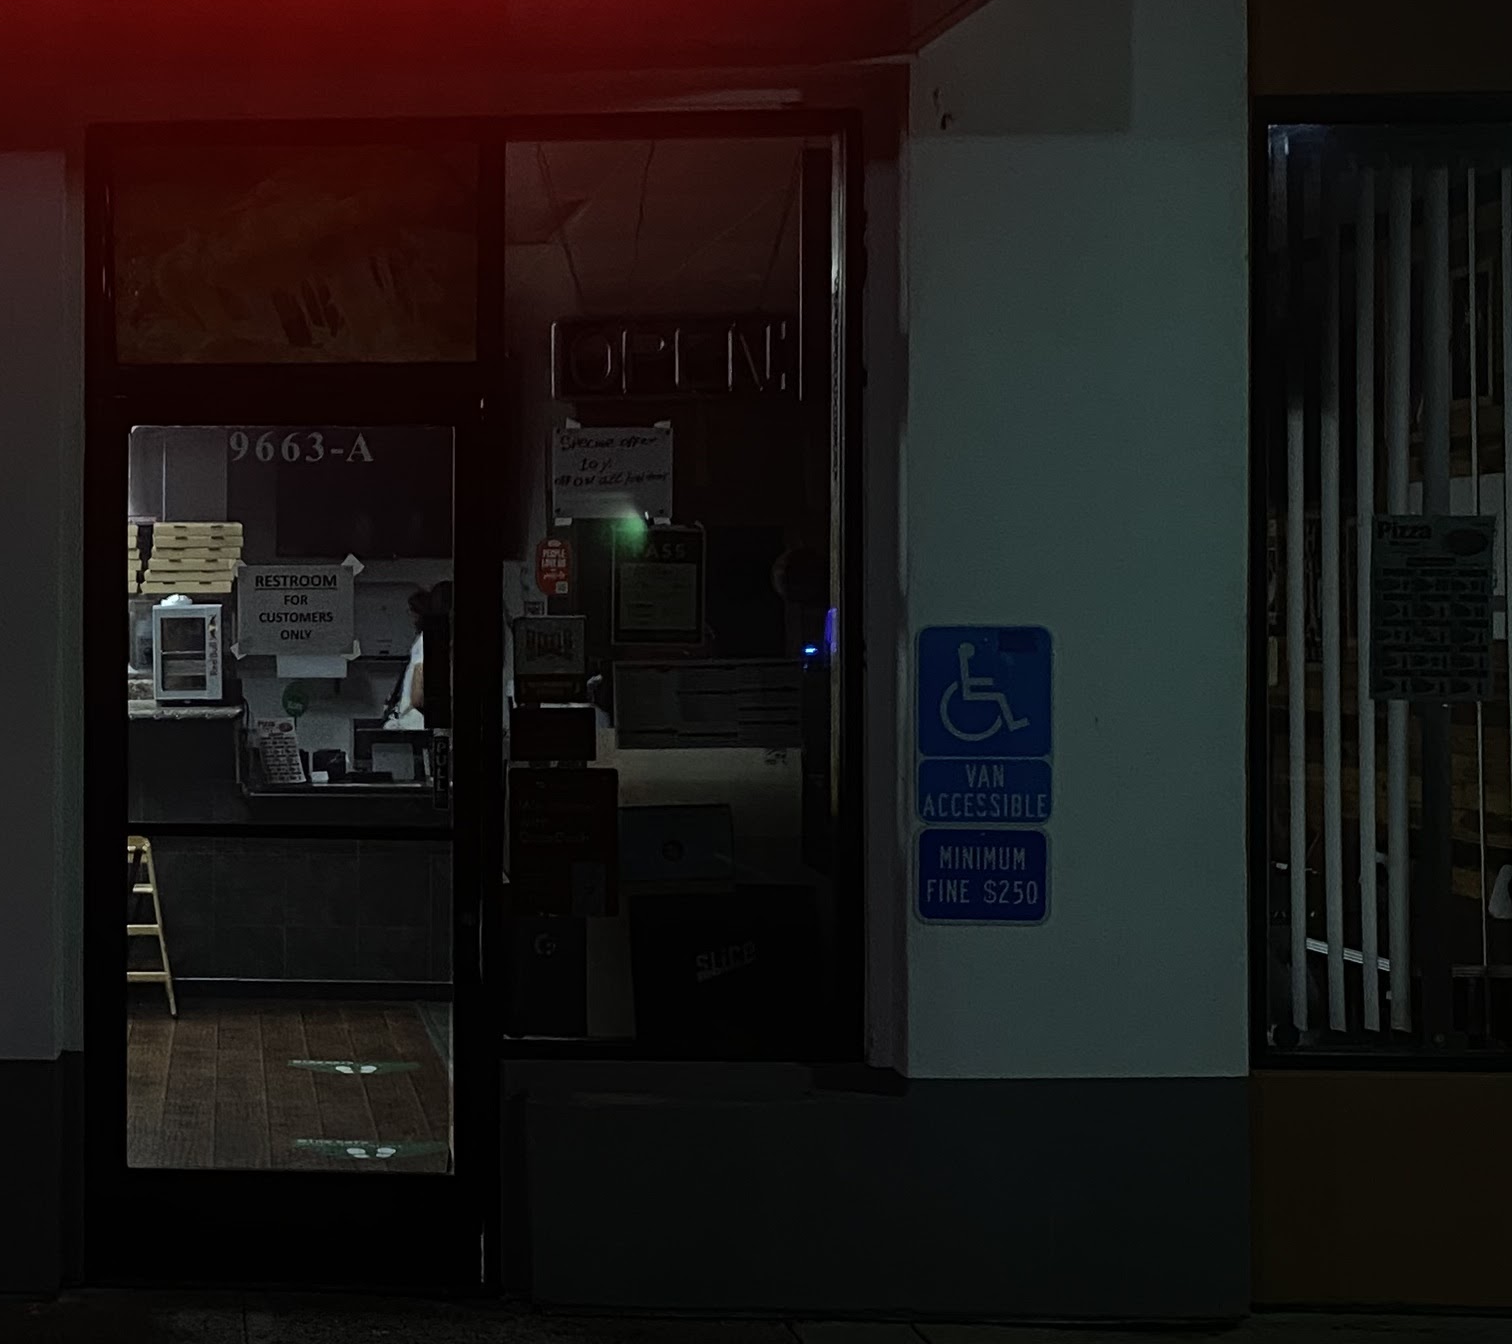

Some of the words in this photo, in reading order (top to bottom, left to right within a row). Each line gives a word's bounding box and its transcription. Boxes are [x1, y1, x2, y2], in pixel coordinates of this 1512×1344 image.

[229, 431, 375, 463] 9663-A
[1377, 520, 1433, 540] Pizza
[255, 574, 338, 590] RESTROOM
[283, 594, 308, 606] FOR
[258, 612, 334, 623] CUSTOMERS
[280, 629, 312, 641] ONLY
[964, 764, 1005, 789] VAN
[922, 792, 1049, 818] ACCESSIBLE
[938, 845, 1027, 872] MINIMUM
[925, 878, 971, 904] FINE
[983, 878, 1038, 905] $250
